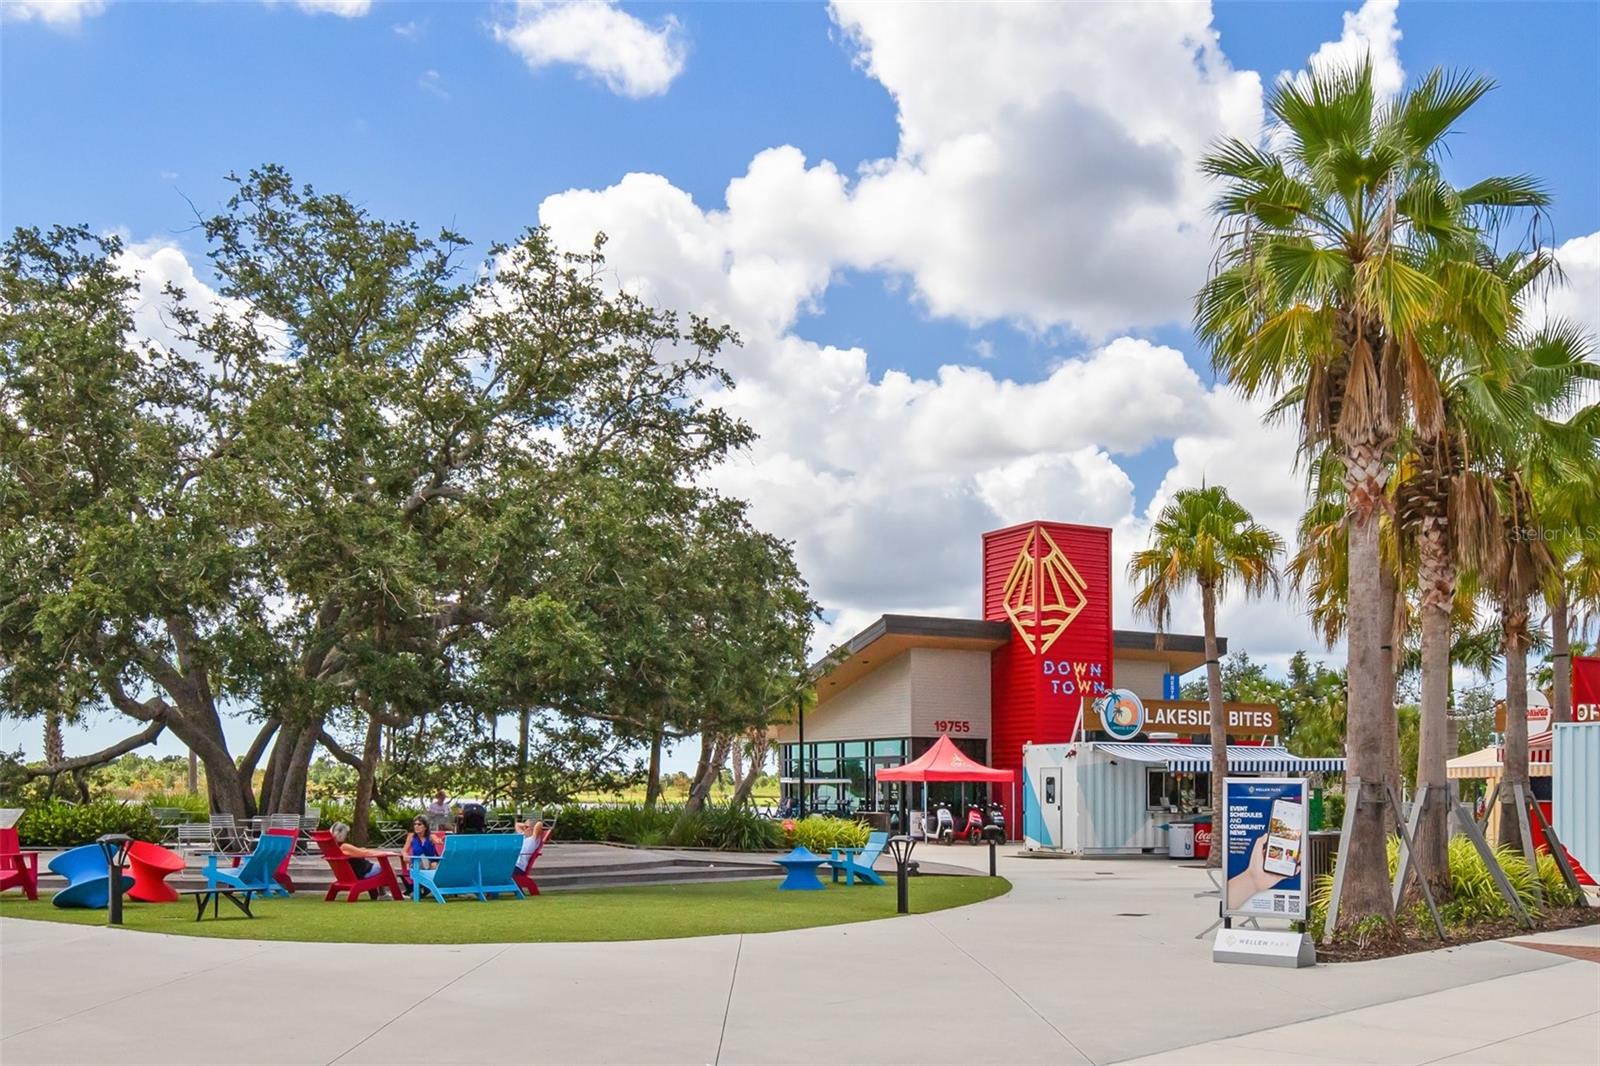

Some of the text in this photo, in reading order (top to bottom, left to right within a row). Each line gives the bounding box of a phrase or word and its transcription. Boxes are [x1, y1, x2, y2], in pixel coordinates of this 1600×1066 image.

[1043, 660, 1101, 677] DOWN
[1051, 680, 1105, 695] TOWN
[1145, 707, 1272, 727] LAKESID BITES
[934, 720, 970, 732] 19755
